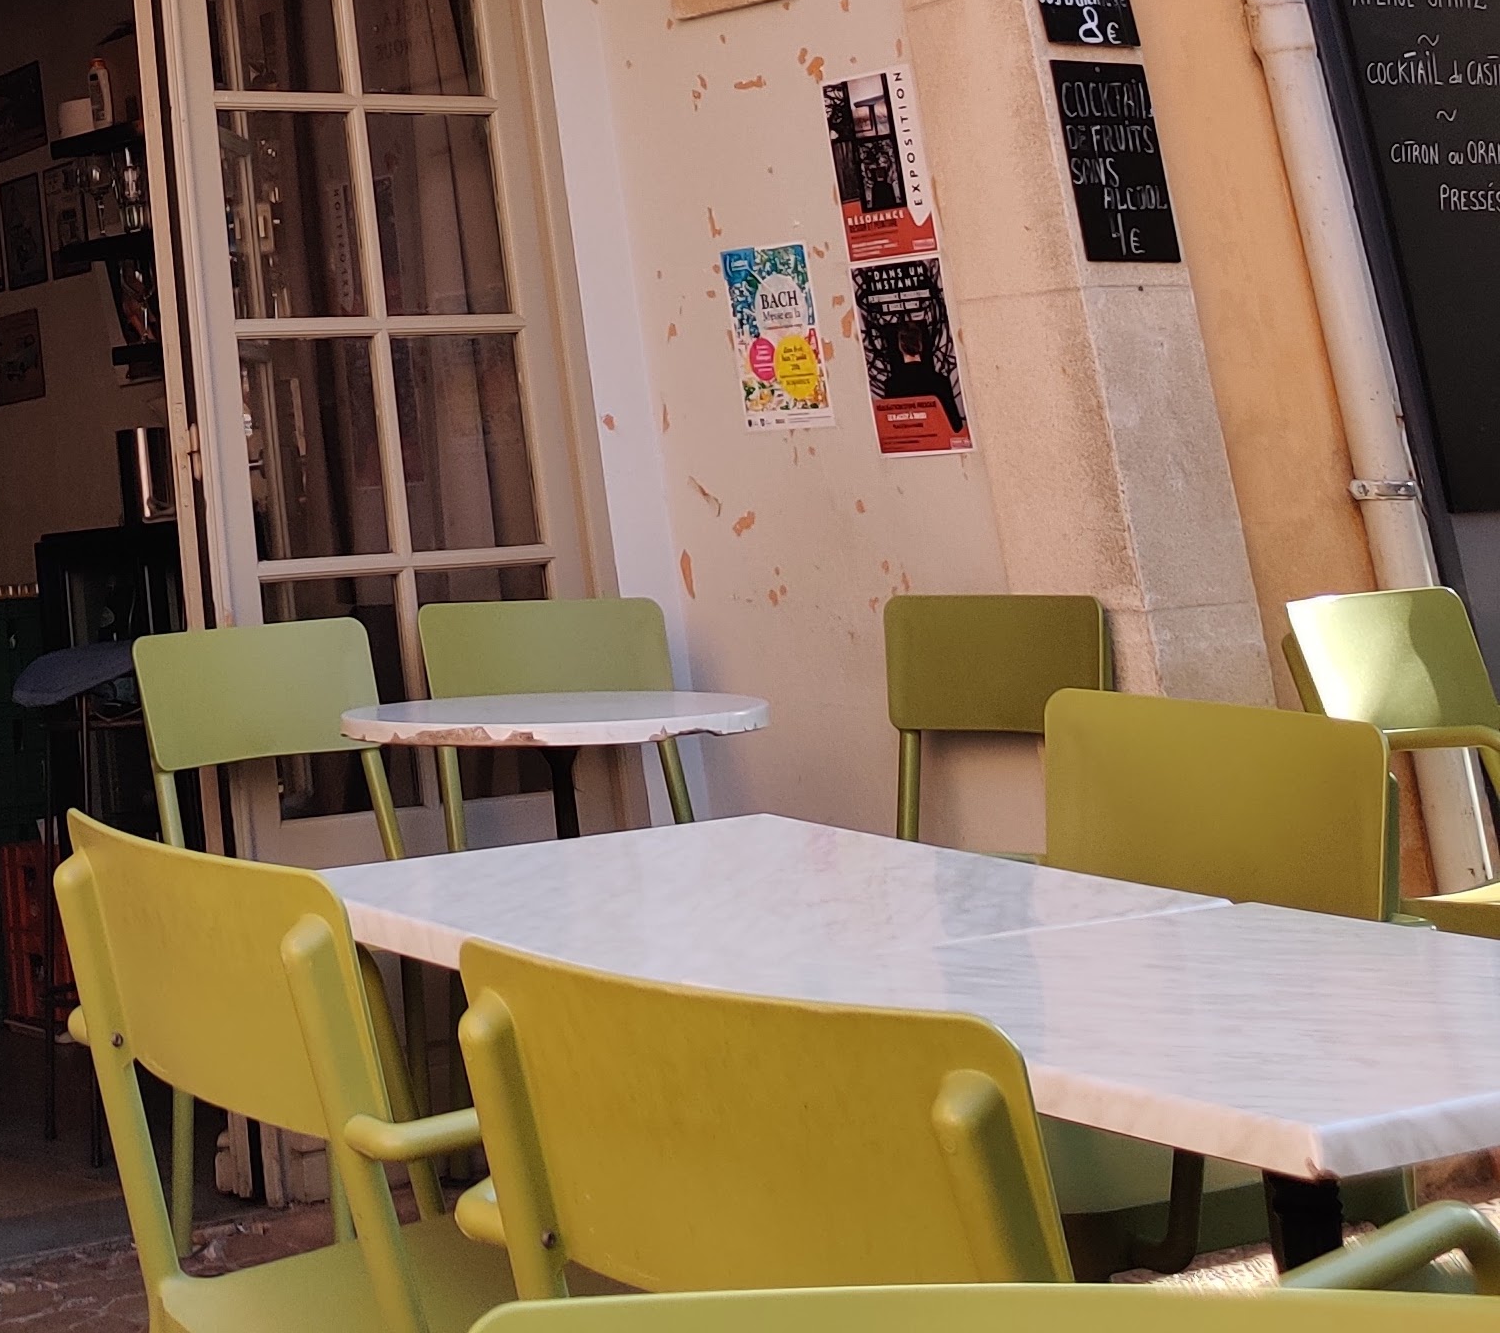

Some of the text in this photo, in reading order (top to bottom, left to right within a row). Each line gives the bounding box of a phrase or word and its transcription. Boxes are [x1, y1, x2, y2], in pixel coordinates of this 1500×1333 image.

[1366, 51, 1443, 85] COCKTAIL
[893, 72, 923, 206] EXPOSITION
[1090, 121, 1155, 153] FRUITS
[1390, 140, 1500, 165] CITRON ou ORA
[760, 290, 799, 309] BACH
